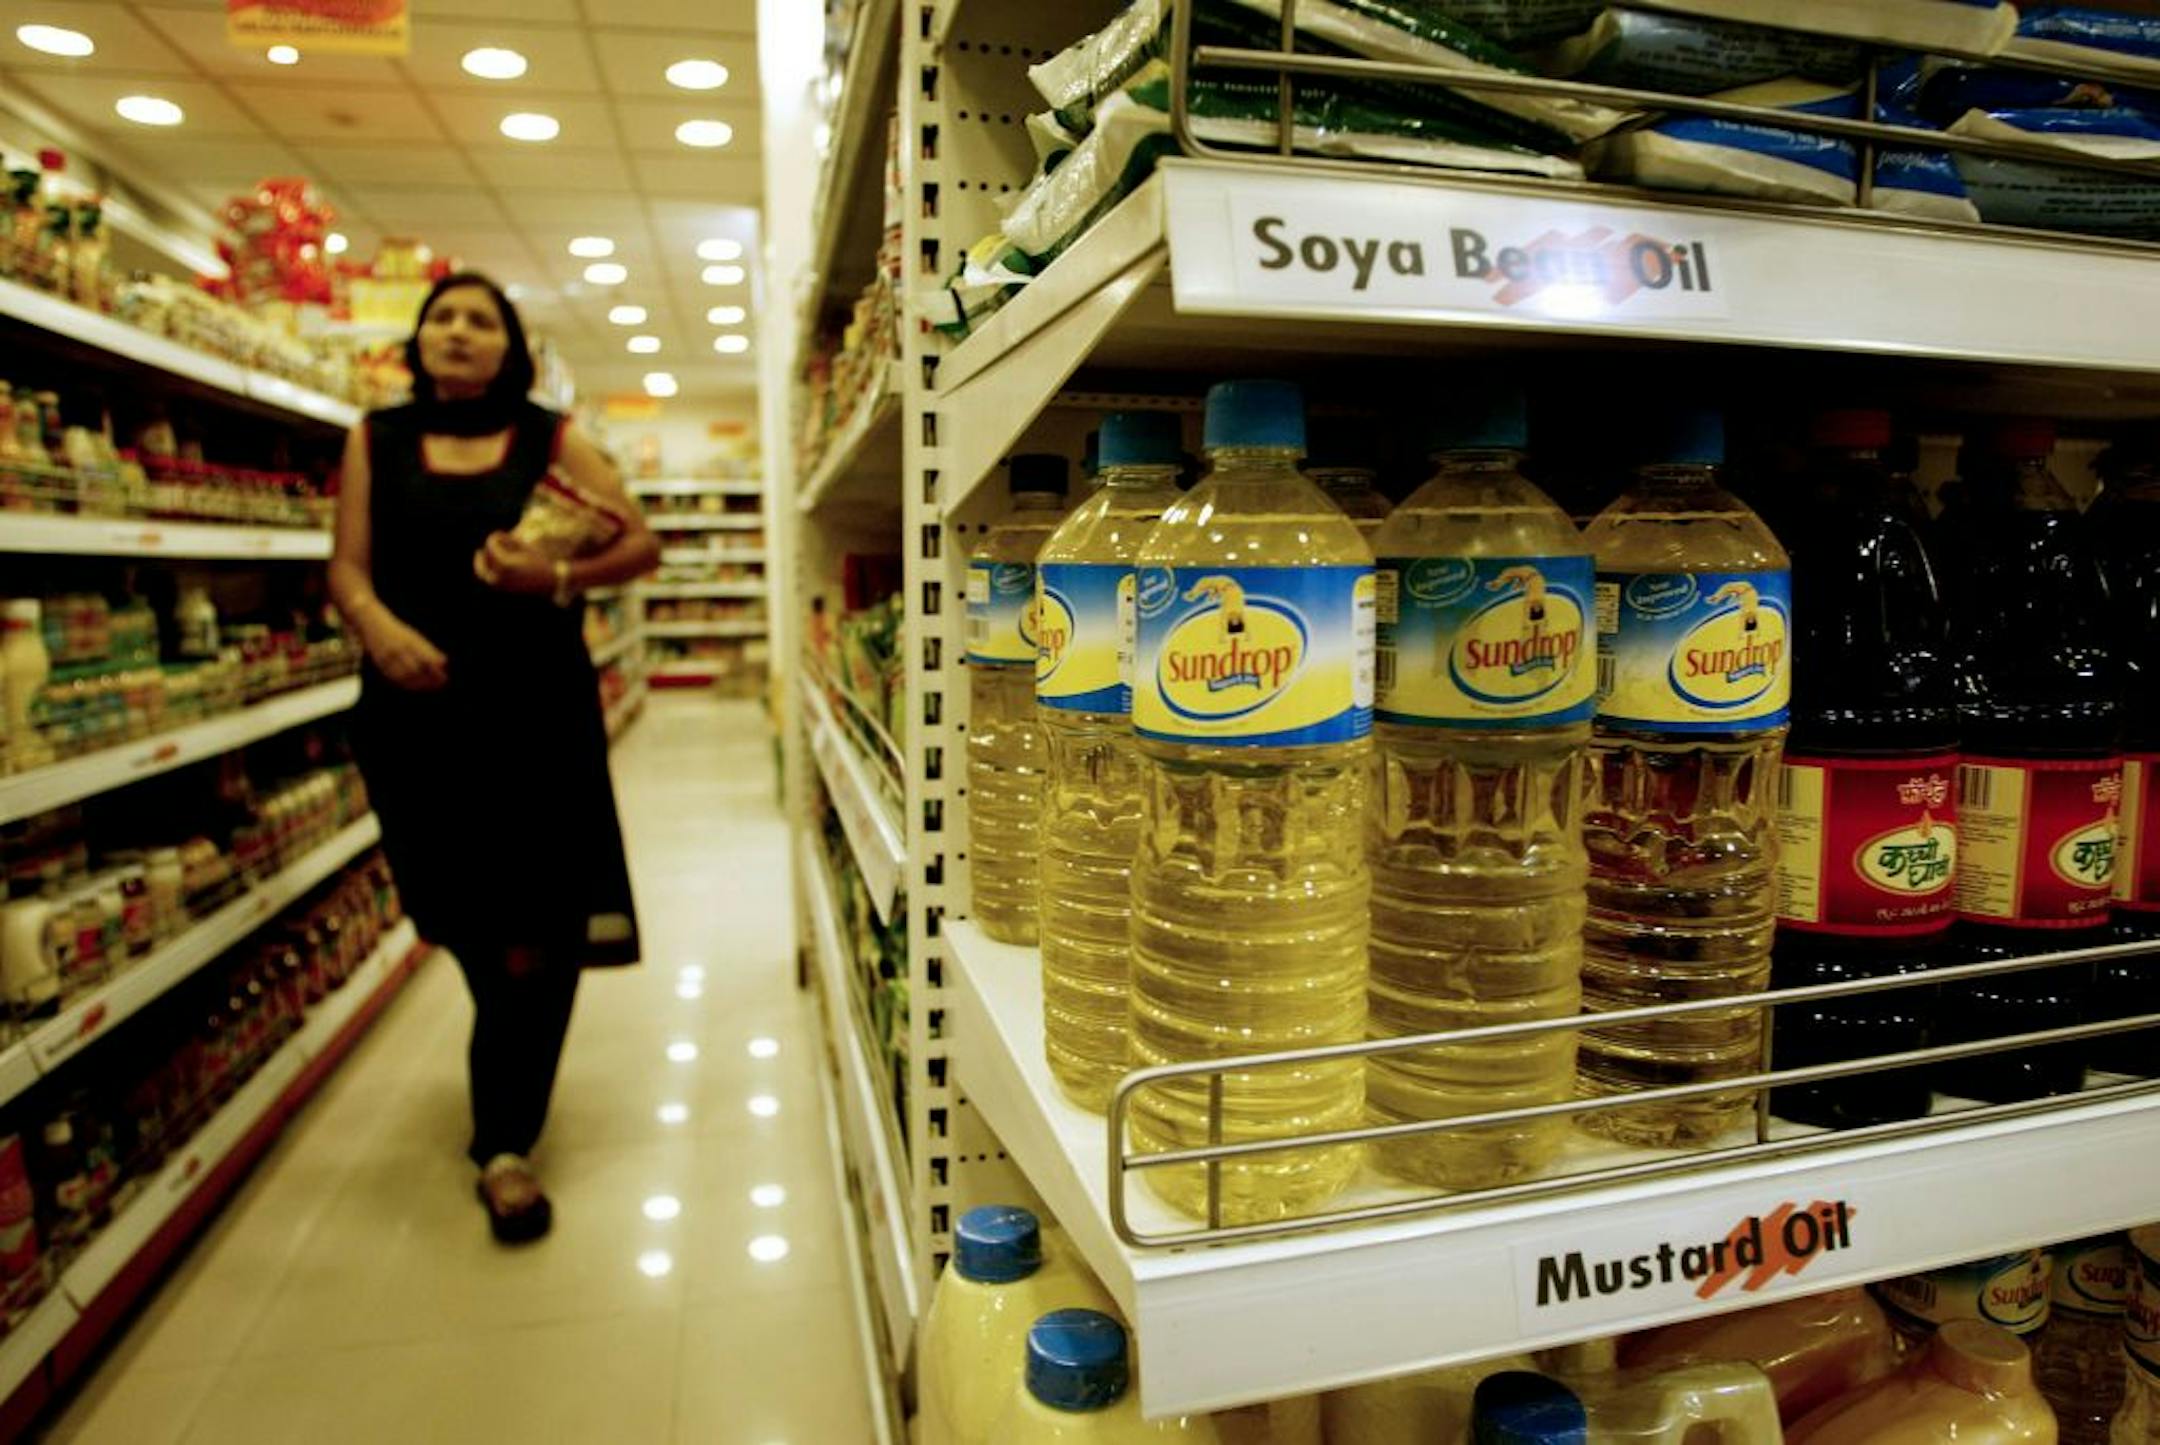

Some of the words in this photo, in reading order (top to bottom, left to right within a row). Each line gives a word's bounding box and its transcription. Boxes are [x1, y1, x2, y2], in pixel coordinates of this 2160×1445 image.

[1253, 216, 1425, 291] Soya
[1629, 241, 1712, 292] Oil
[1168, 637, 1292, 689] Sundrop
[1465, 624, 1578, 670] Sundrop
[1685, 635, 1783, 677] Sundrop
[1537, 1216, 1764, 1307] Mustard
[1782, 1200, 1850, 1259] Oil
